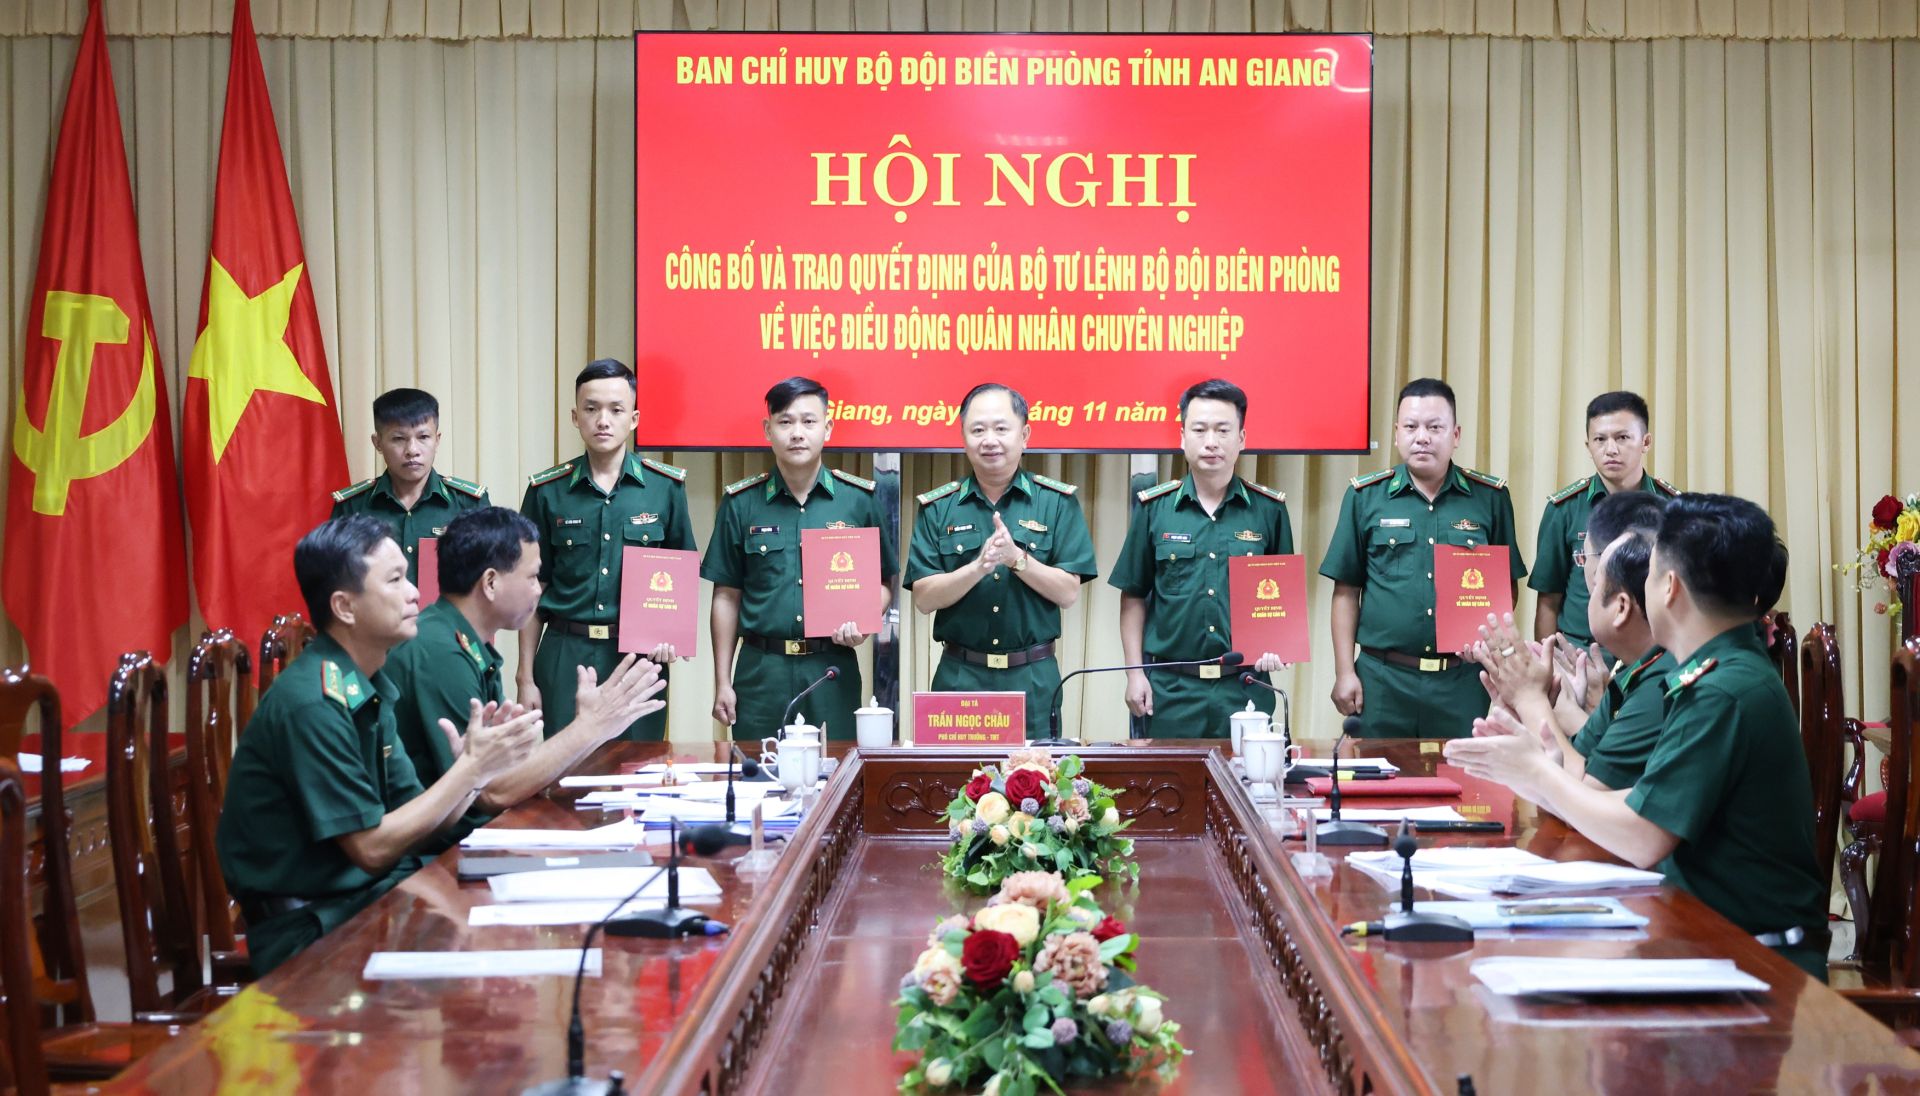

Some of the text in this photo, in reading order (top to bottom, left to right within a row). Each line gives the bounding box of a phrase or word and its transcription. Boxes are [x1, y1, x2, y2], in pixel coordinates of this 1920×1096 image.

[677, 48, 1331, 91] BAN CHỈ HUY BỘ ĐỘI BIÊN PHÒNG TỈNH AN GIANG
[810, 134, 1197, 223] HỘI NGHỊ
[665, 240, 1340, 300] CÔNG BỐ VÀ TRAO QUYẾT ĐỊNH CỦA BỘ TƯ LỆNH BỘ ĐỘI BIÊN PHÒNG
[760, 301, 1244, 360] VỀ VIỆC ĐIỀU ĐỘNG QUÂN NHÂN CHUYÊN NGHIỆP
[901, 400, 960, 426] ngày
[1029, 401, 1074, 426] áng
[1083, 401, 1107, 422] 11
[1114, 401, 1167, 422] năm
[955, 714, 982, 730] NGỌC
[984, 712, 1010, 728] CHÂU
